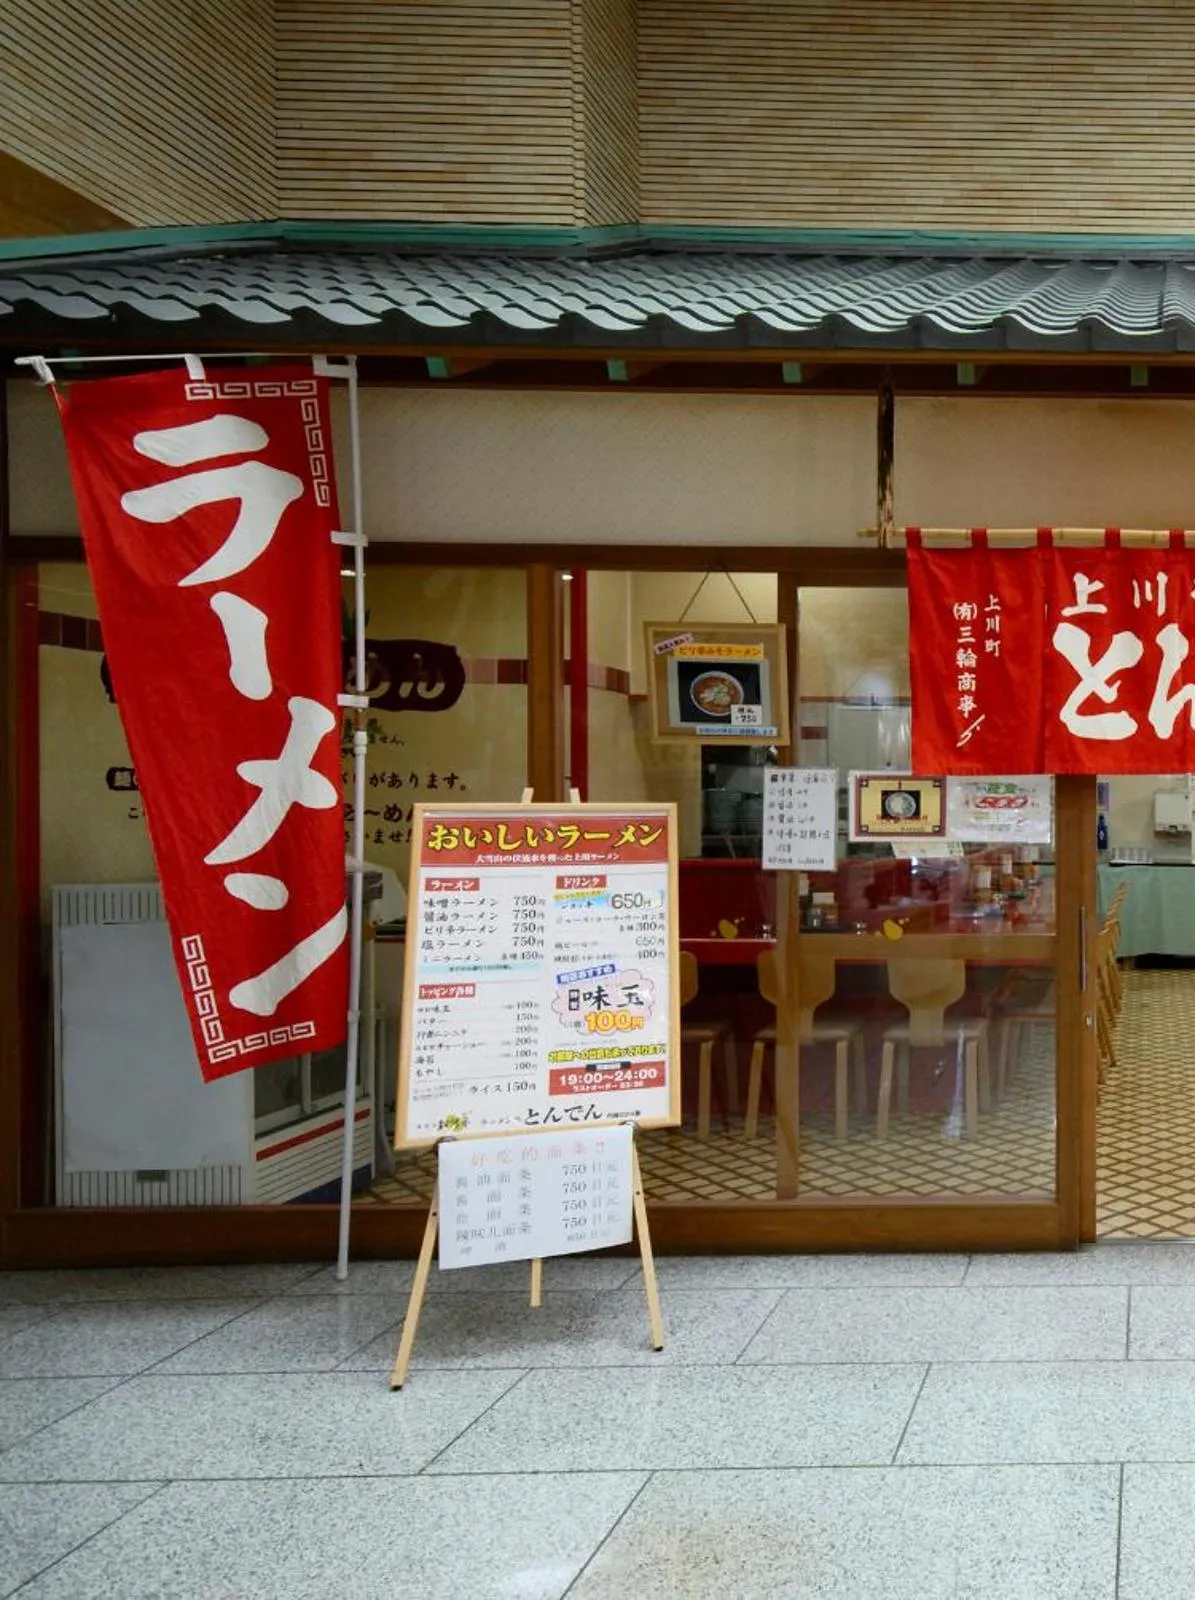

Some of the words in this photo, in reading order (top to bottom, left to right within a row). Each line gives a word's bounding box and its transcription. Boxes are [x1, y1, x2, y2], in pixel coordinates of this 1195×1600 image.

[984, 593, 1001, 657] 上川町
[121, 414, 347, 1016] ラーメン
[426, 822, 664, 852] おいしいラーメン
[584, 1010, 644, 1033] 100円
[525, 1104, 604, 1126] とんでん
